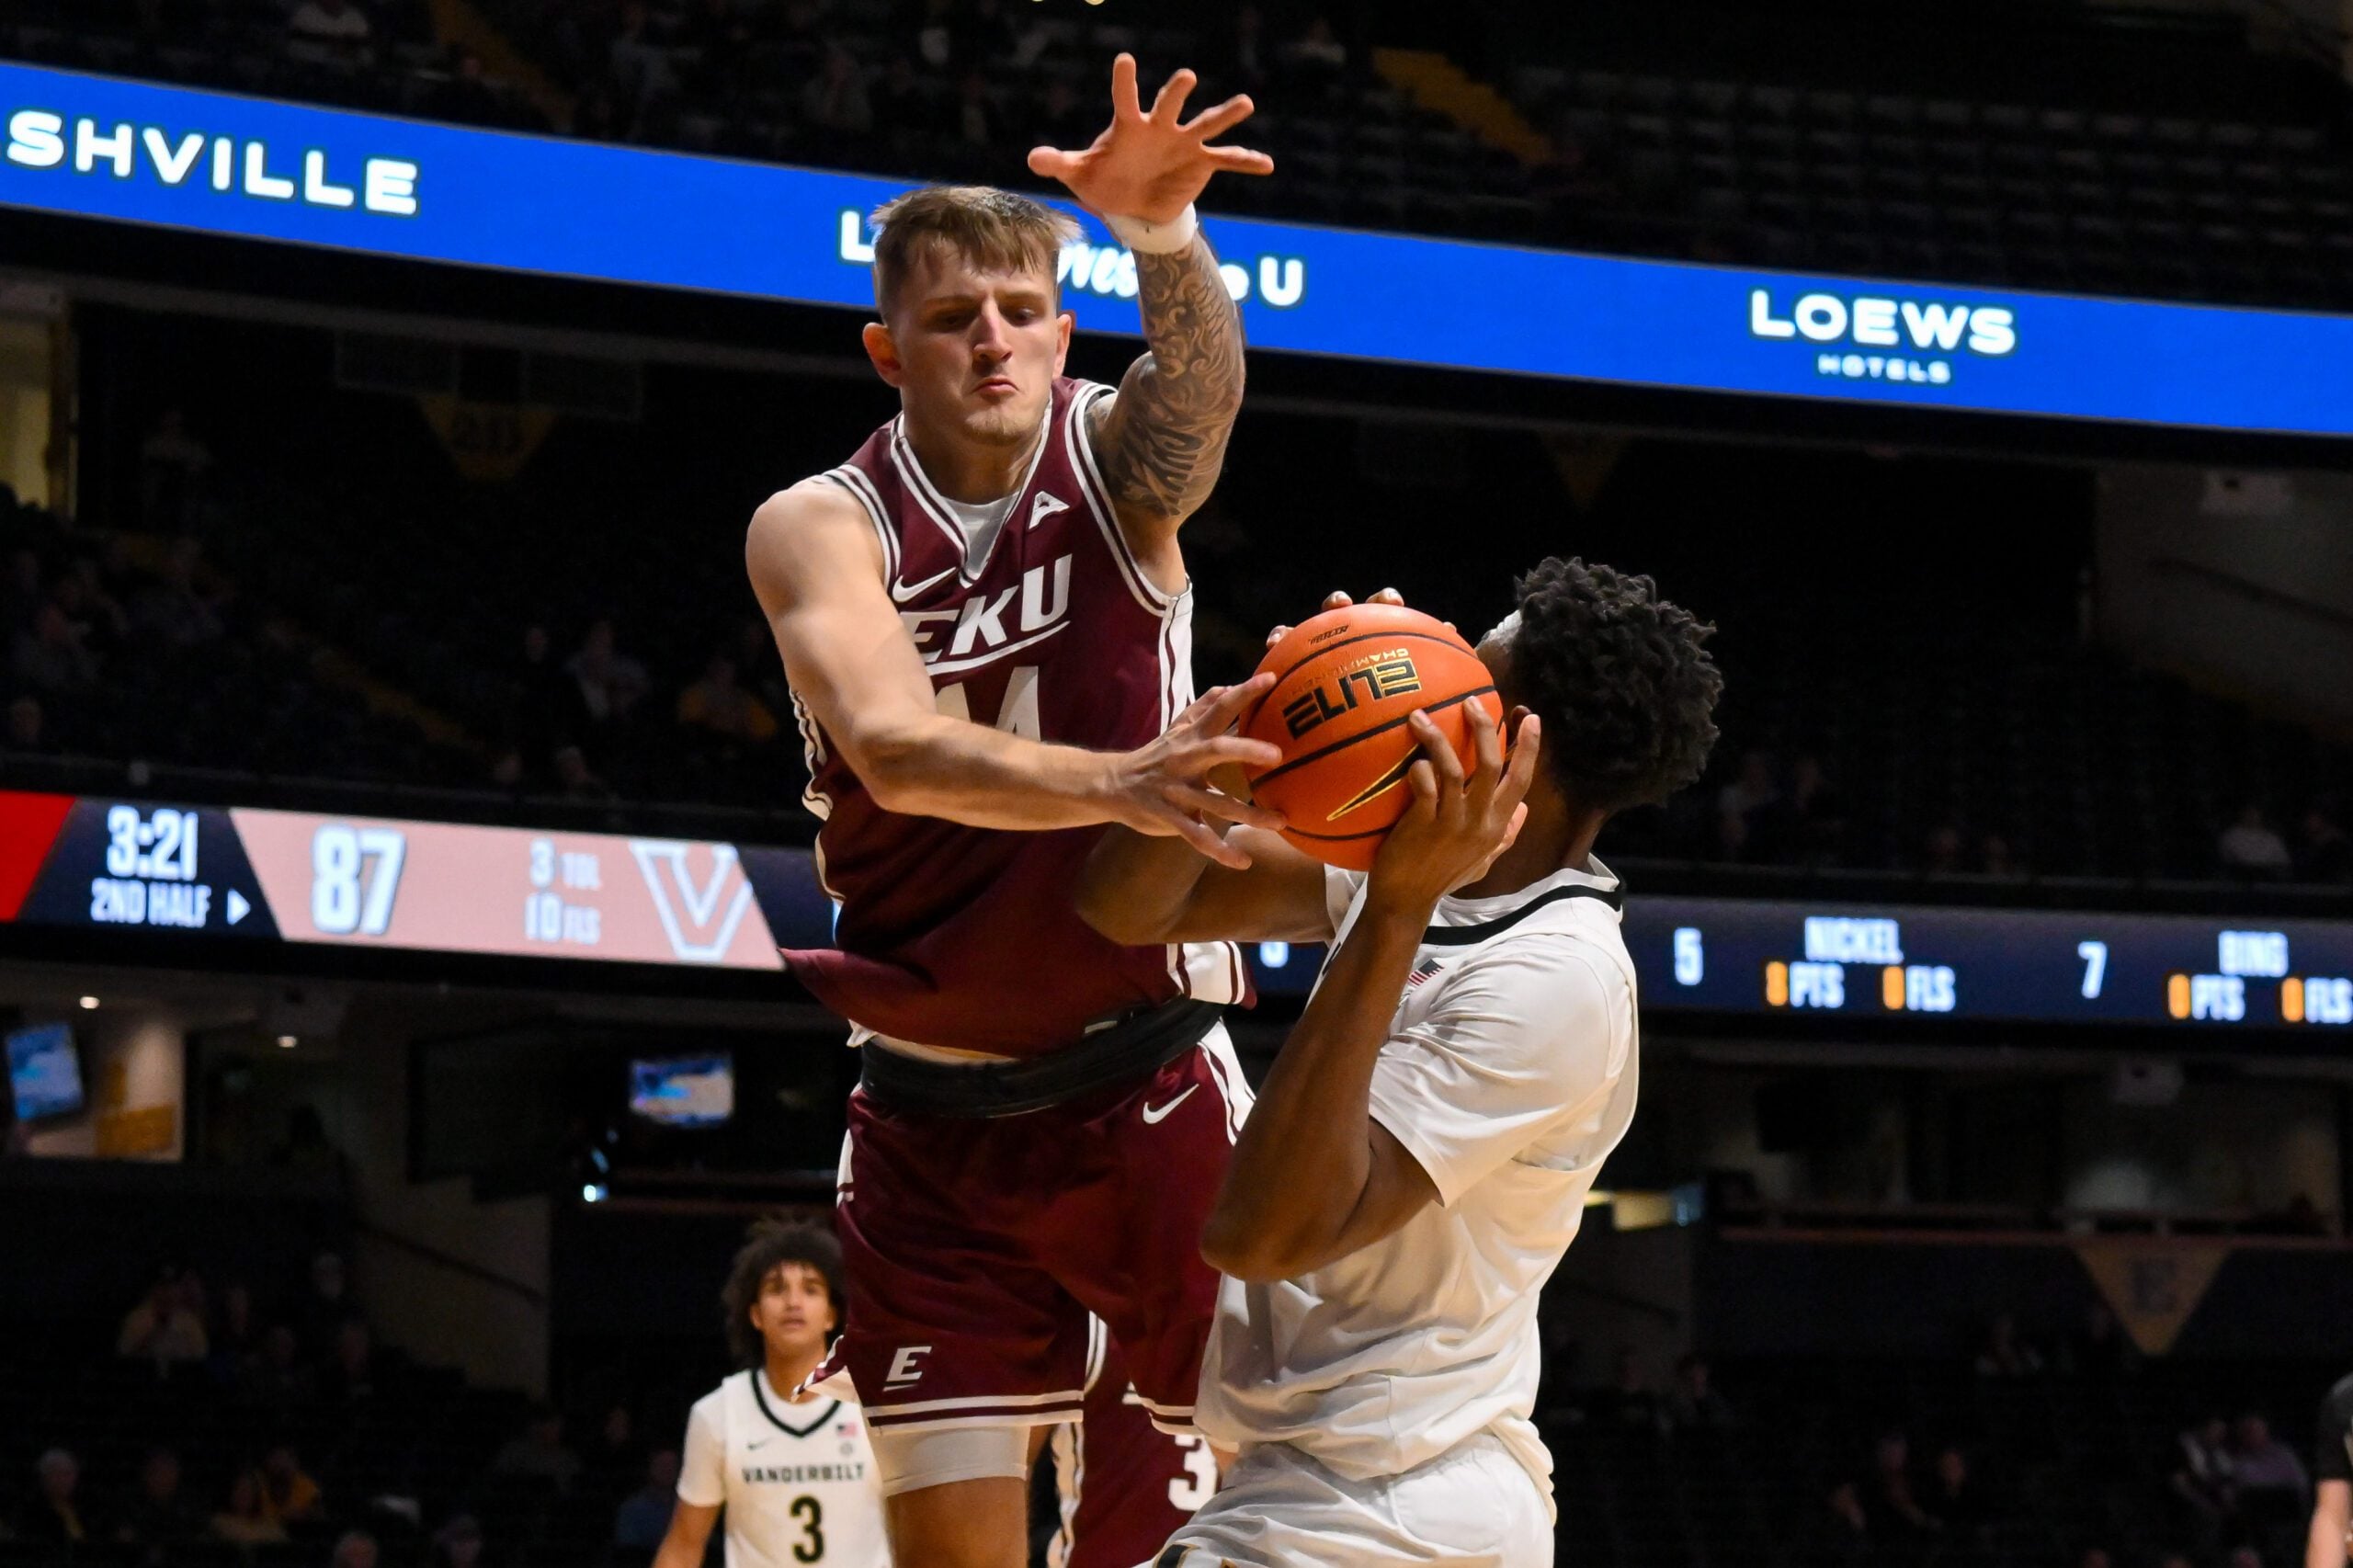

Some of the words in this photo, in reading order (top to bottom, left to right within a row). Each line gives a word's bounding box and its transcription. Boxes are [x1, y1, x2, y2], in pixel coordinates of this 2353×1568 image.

[7, 110, 417, 215] SHVILLE
[1260, 256, 1303, 306] U
[1751, 290, 2016, 355] LOEWS
[1817, 353, 1950, 384] HOTELS
[900, 553, 1073, 663] EKU
[1282, 657, 1422, 741] ELITE
[107, 804, 199, 882] 3:21
[90, 877, 147, 925] 2ND
[148, 881, 212, 928] HALF
[311, 824, 406, 936] 87
[1674, 926, 1703, 985] 5
[1789, 961, 1845, 1008] PTS
[2077, 941, 2108, 999] 7
[742, 1462, 864, 1483] VANDERBILT
[1168, 1434, 1218, 1512] 3
[790, 1495, 824, 1563] 3
